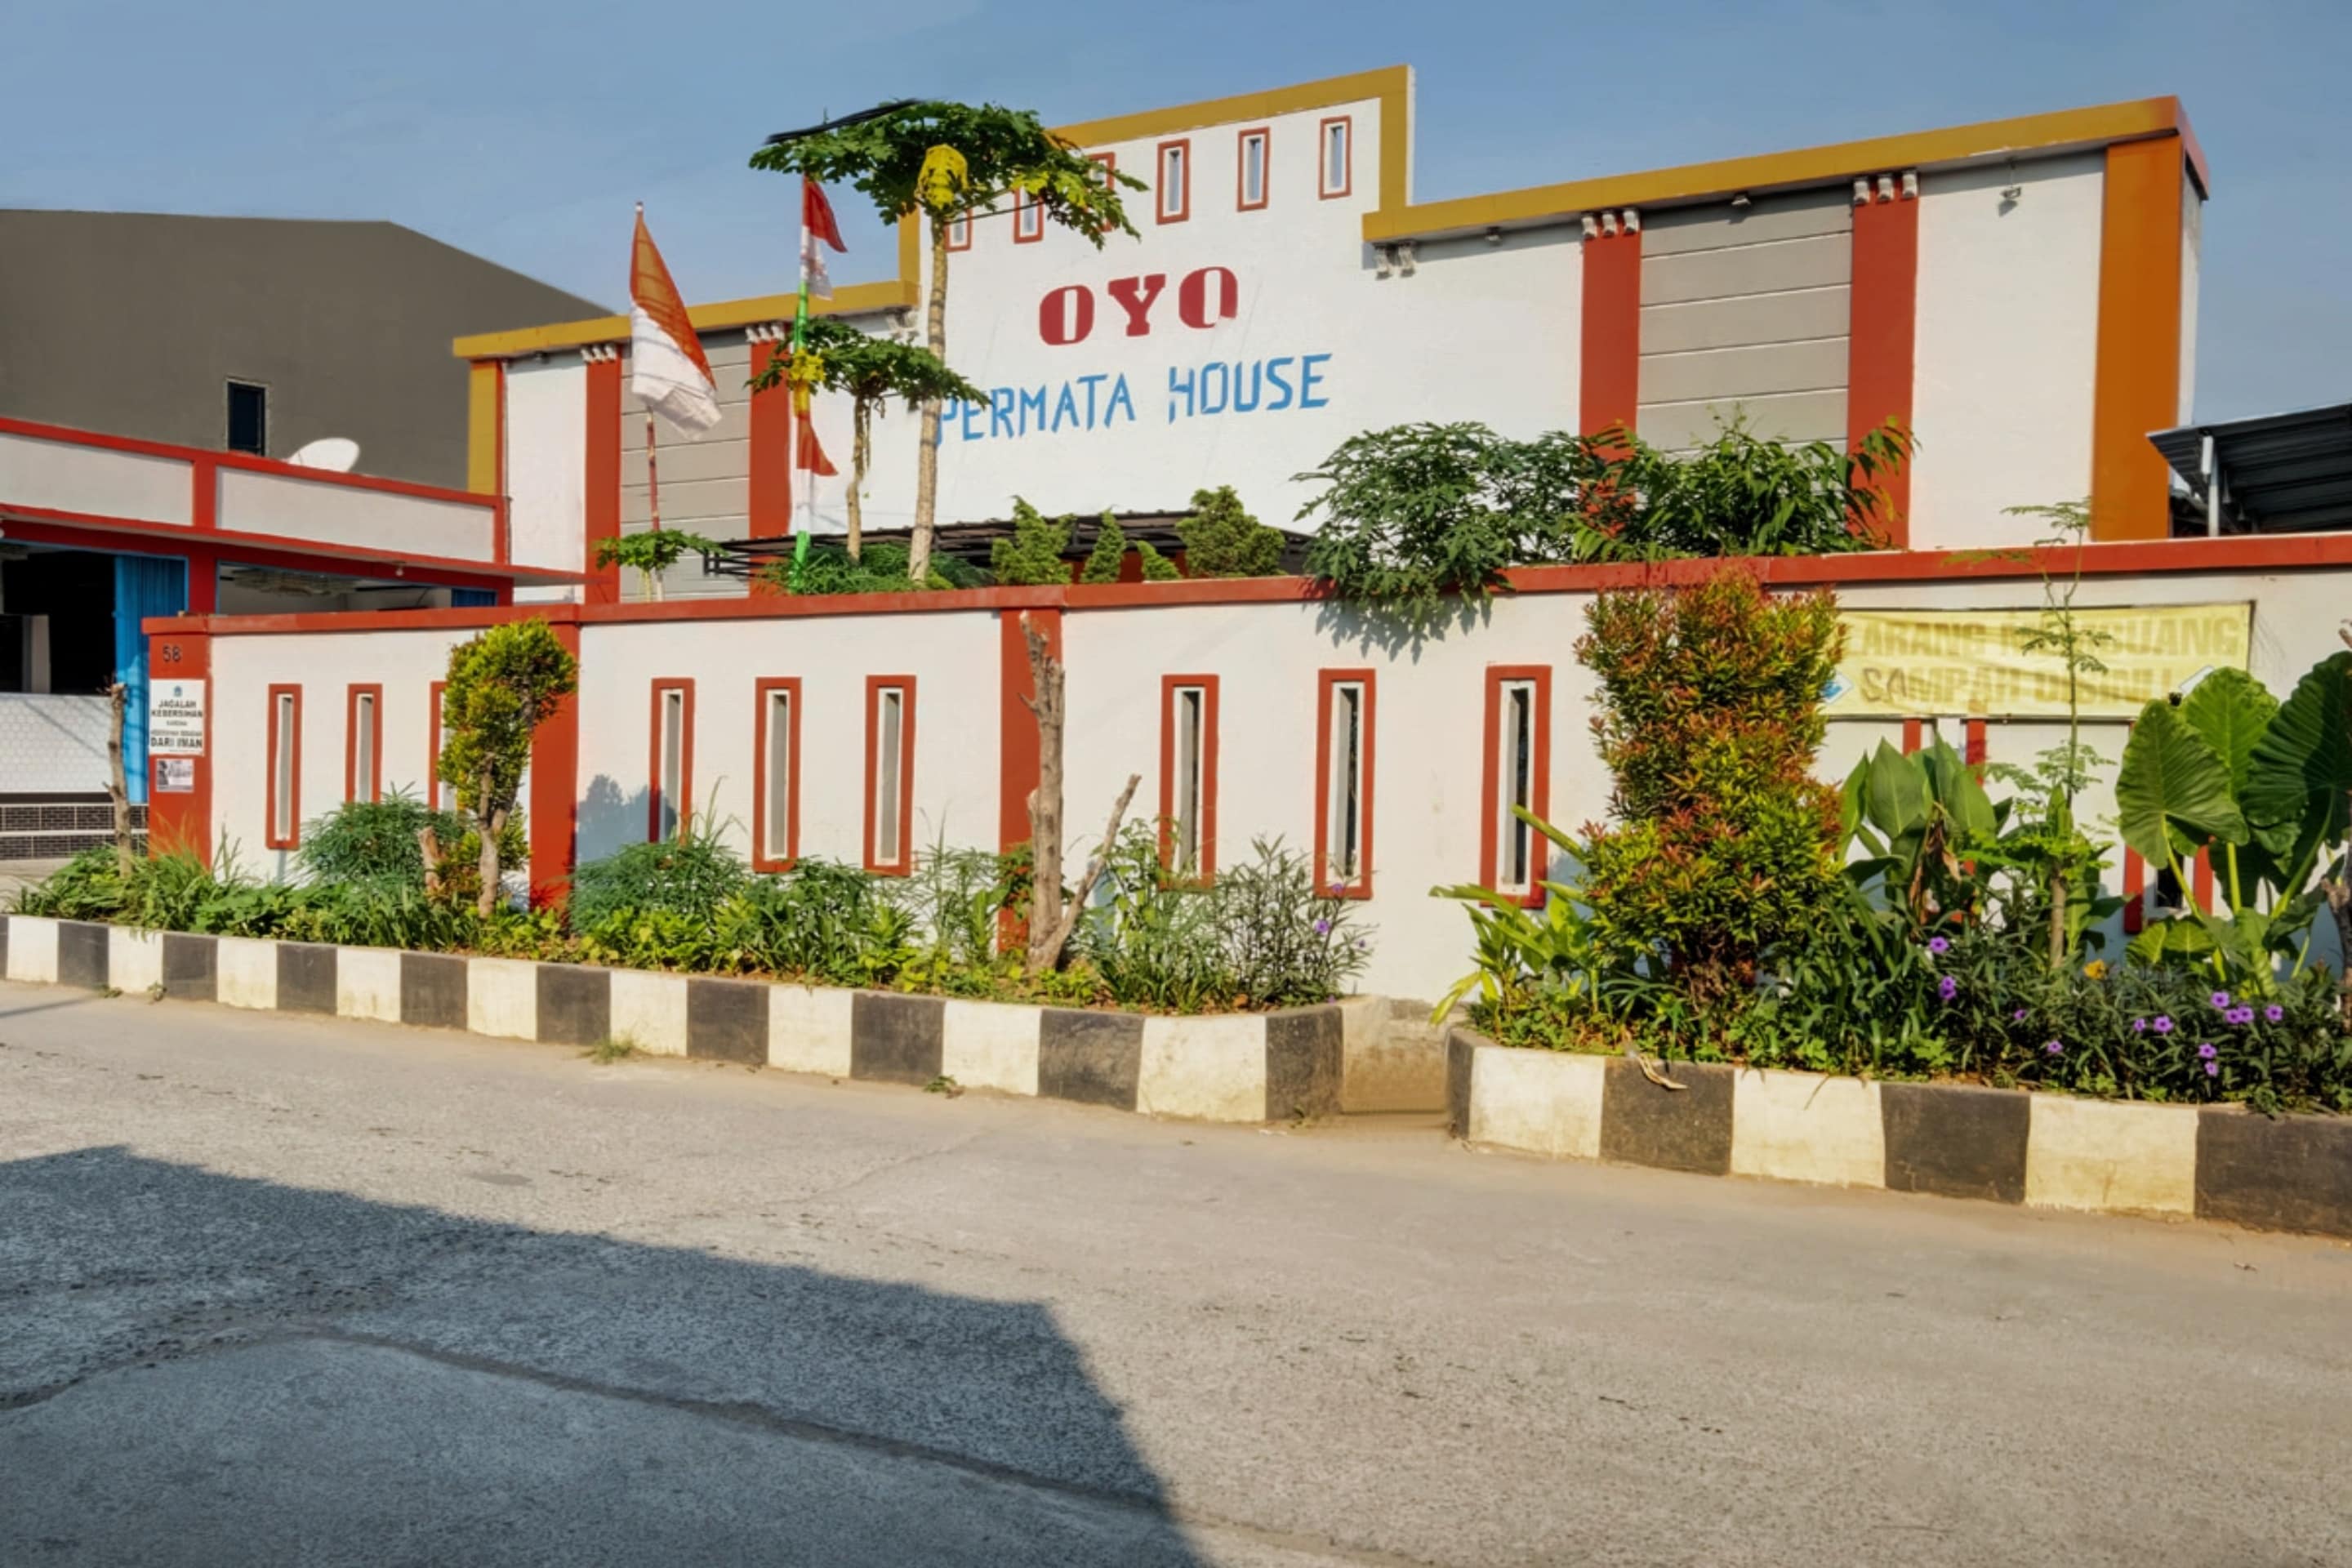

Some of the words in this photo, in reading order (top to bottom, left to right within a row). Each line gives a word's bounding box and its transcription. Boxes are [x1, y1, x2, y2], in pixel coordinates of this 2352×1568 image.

[1039, 266, 1239, 346] OYO
[936, 372, 1137, 447] PERMATA
[1168, 353, 1333, 425] HOUSE
[163, 645, 182, 662] 58
[150, 737, 175, 747] DARI
[176, 737, 203, 748] IMAN
